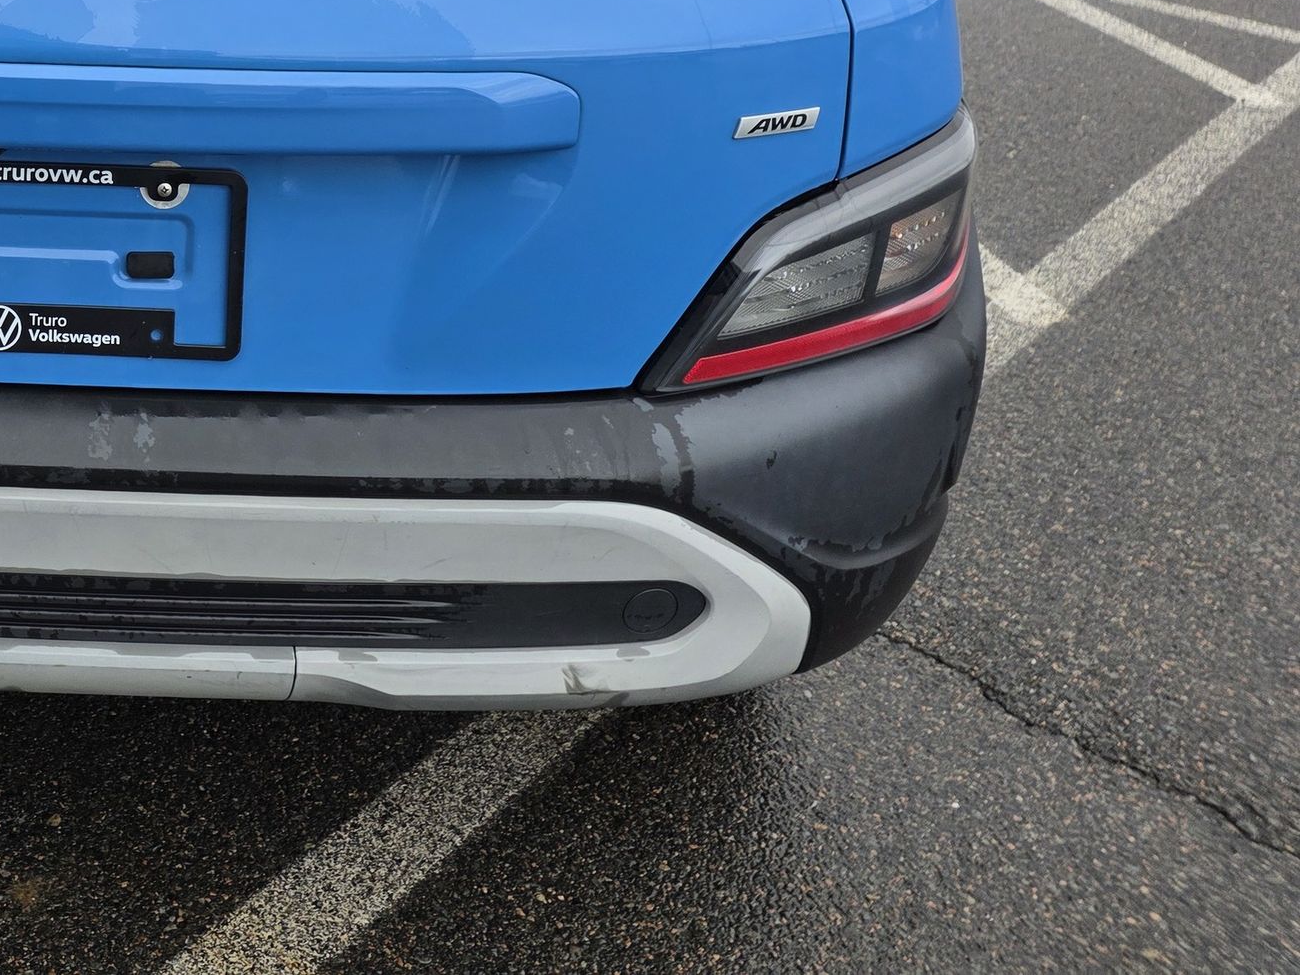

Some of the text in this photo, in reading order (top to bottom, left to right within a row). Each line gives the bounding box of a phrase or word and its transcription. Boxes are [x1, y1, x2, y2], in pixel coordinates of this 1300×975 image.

[747, 113, 807, 134] AWD
[29, 313, 67, 327] Truro
[29, 329, 121, 348] Volkswagen
